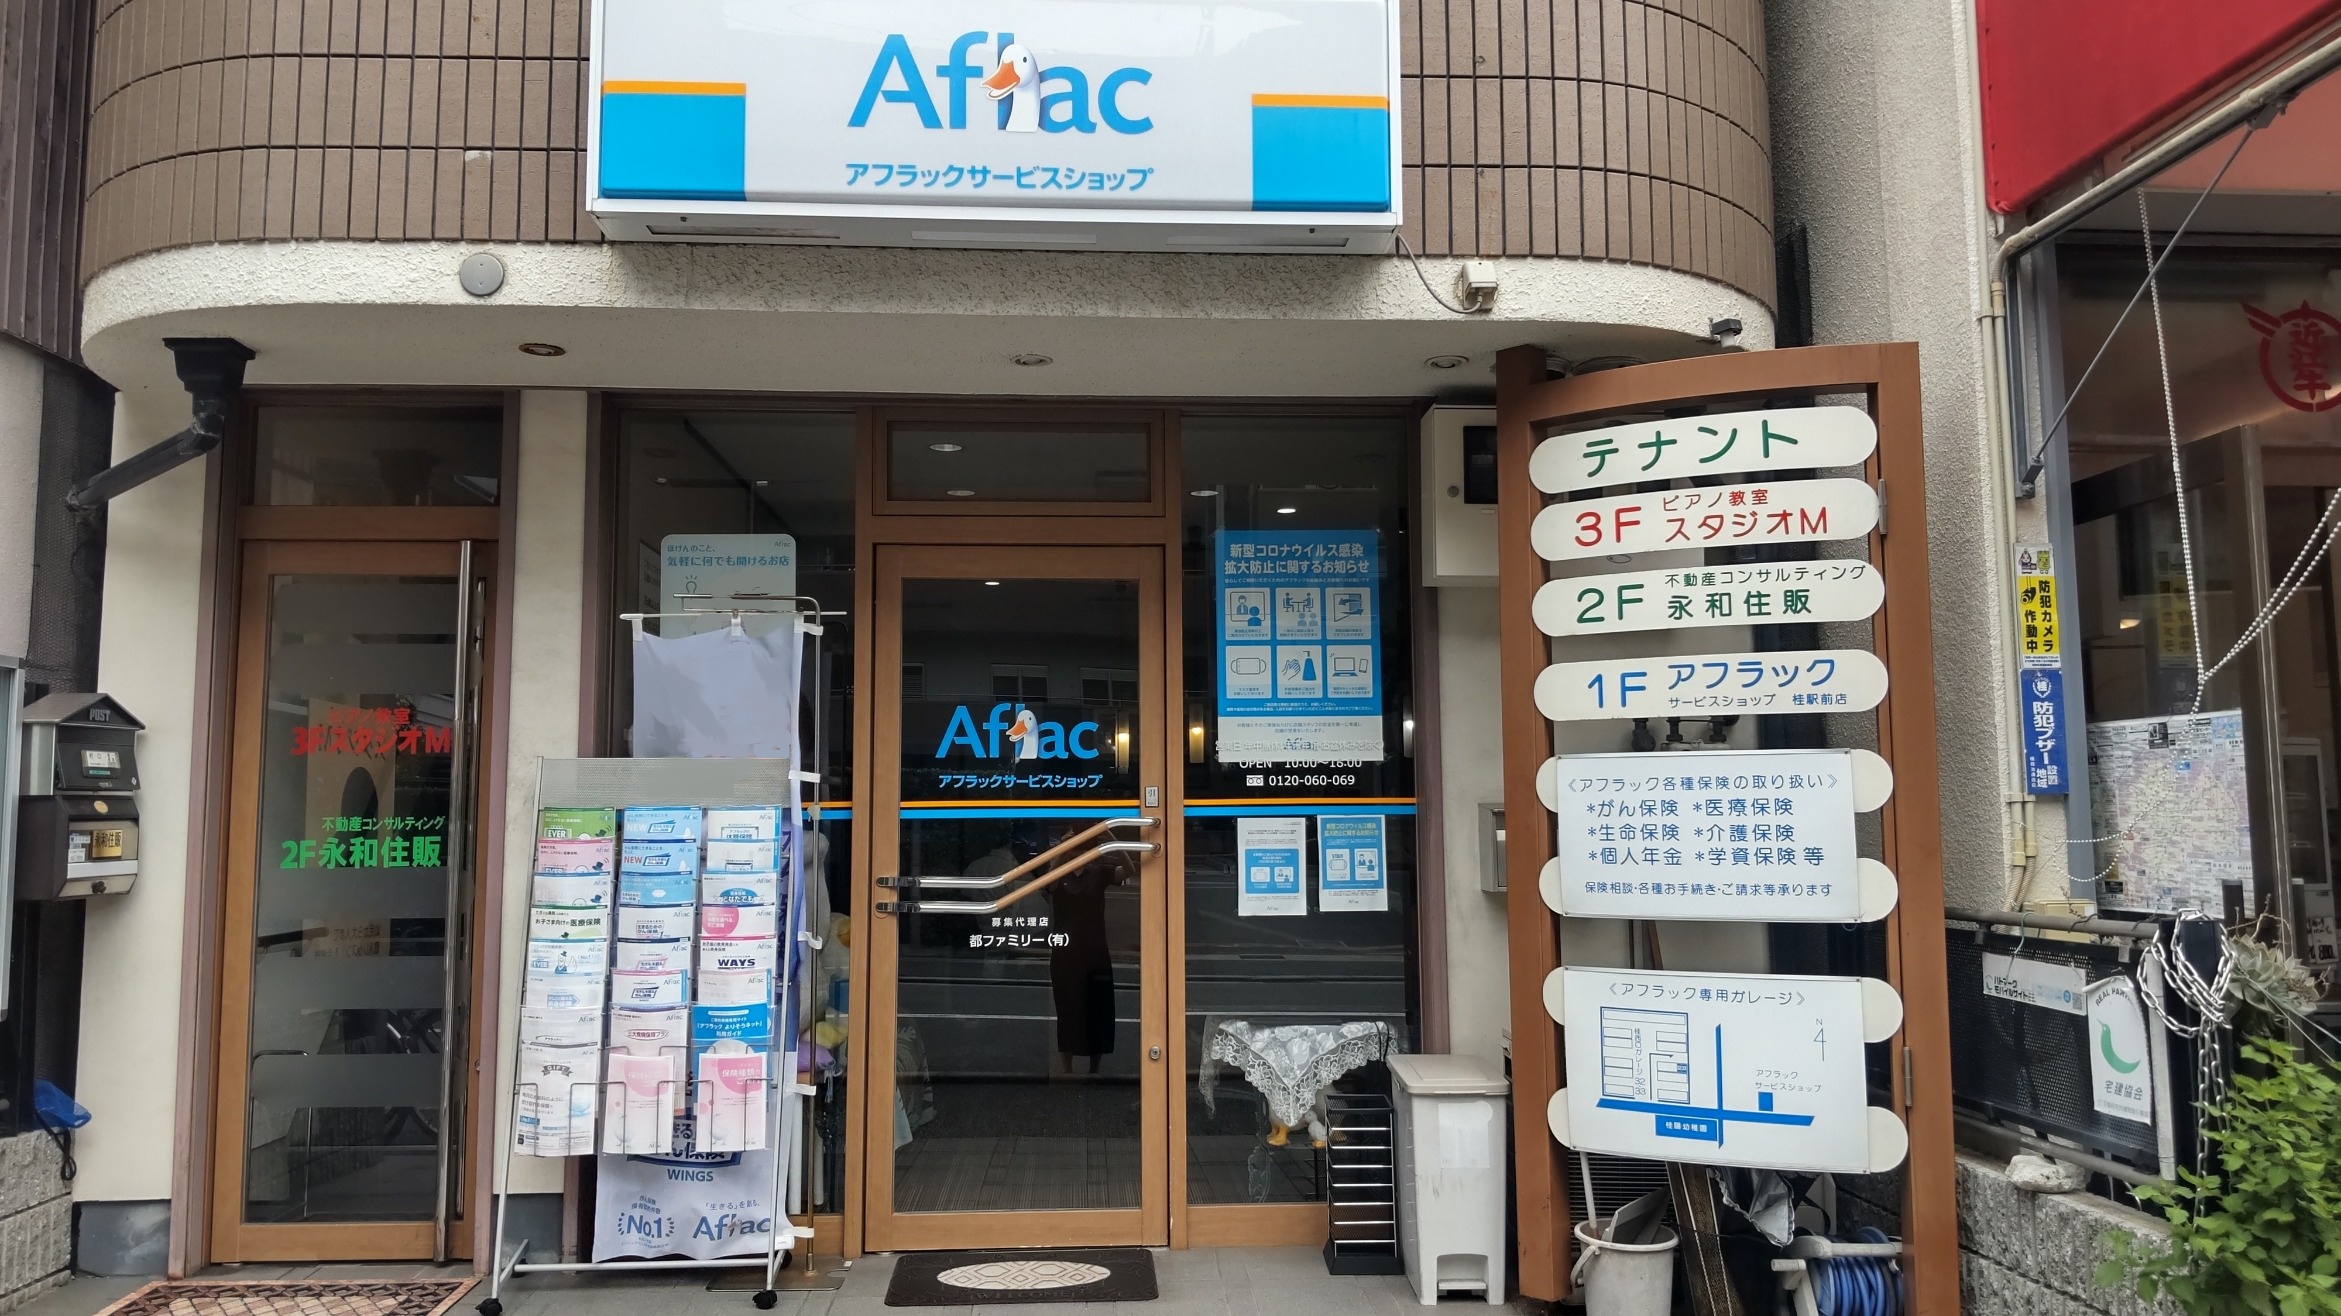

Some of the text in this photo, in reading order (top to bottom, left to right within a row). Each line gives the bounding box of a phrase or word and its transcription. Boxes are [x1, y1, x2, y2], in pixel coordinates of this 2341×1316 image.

[848, 32, 1154, 134] Aflac
[847, 163, 1154, 192] アフラックサービスショップ
[1582, 419, 1799, 478] テナント
[1663, 488, 1768, 512] ピアノ教室
[1574, 506, 1828, 547] 3F スタジオM
[1230, 543, 1364, 558] 新型コロナウイルス感染
[1224, 560, 1370, 575] 拡大防止に関するお知らせ
[1664, 565, 1867, 588] 不動産コンサルティング
[1576, 583, 1812, 624] 2F 永和住販
[2038, 580, 2054, 653] 防犯カメラ
[2024, 609, 2038, 653] 作動中
[1588, 658, 1835, 709] 1F アフラック
[1668, 693, 1848, 709] サービスショップ 桂駅前店
[89, 709, 111, 722] POST
[329, 707, 411, 725] ピアノ教室
[935, 703, 1099, 760] Aflac
[2032, 701, 2055, 765] 防犯ブザー
[939, 774, 1103, 788] アフラックサービスショップ
[1269, 775, 1355, 786] 0120-060-069
[322, 815, 446, 832] 不動産コンサルティング
[548, 830, 566, 838] EVER
[624, 856, 643, 864] NEW
[991, 917, 1049, 927] 募集代理店
[969, 933, 1069, 948] 都ファミリー(有)
[718, 959, 755, 967] WAYS
[1994, 985, 2028, 999] モバイルサイト
[2095, 989, 2110, 1007] REAL
[1815, 1018, 1823, 1026] N
[1755, 1069, 1798, 1080] アフラック
[1754, 1081, 1823, 1093] サービスショップ
[2104, 1080, 2143, 1101] 宅建協会
[667, 1168, 714, 1182] WINGS
[626, 1214, 662, 1239] No.1
